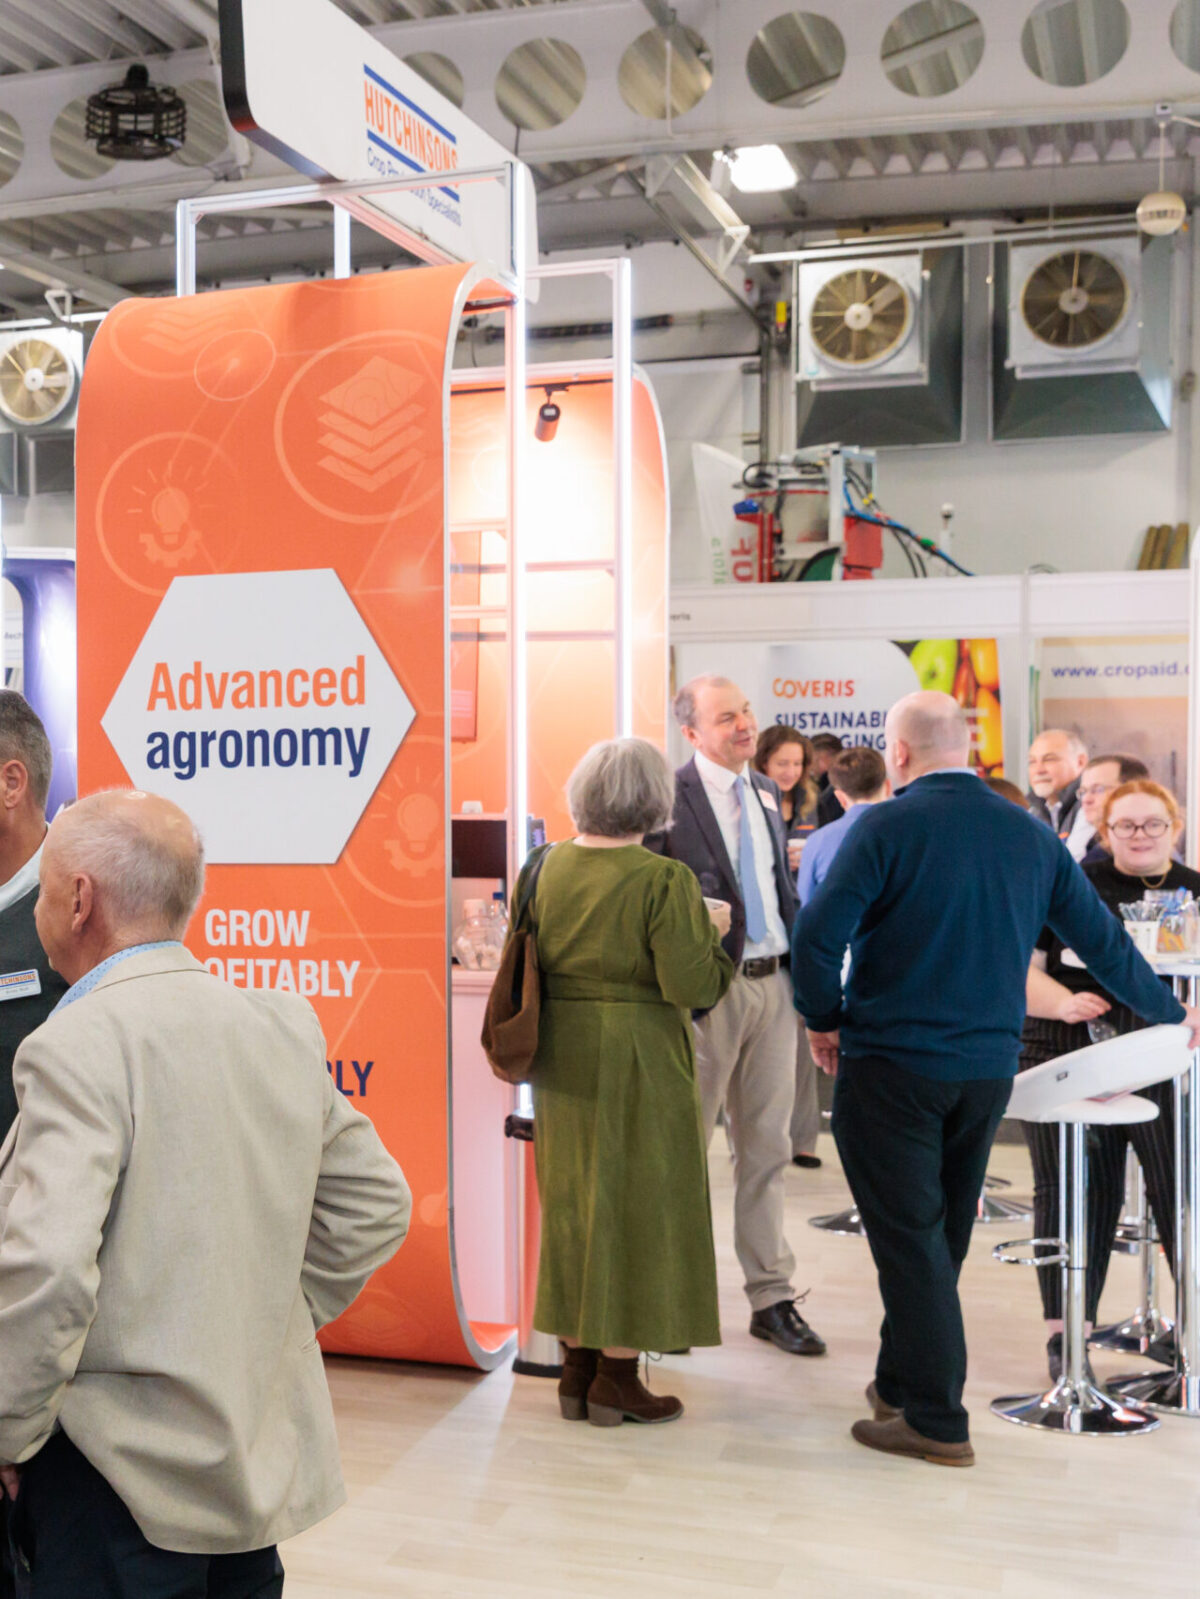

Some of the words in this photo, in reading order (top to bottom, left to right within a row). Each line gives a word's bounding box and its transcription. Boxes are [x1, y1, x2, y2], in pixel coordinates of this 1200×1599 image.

[364, 80, 458, 188] HUTCHINSONS
[147, 655, 366, 711] Advanced
[773, 678, 855, 698] COVERIS
[147, 727, 370, 780] agronomy
[205, 909, 310, 947] GROW
